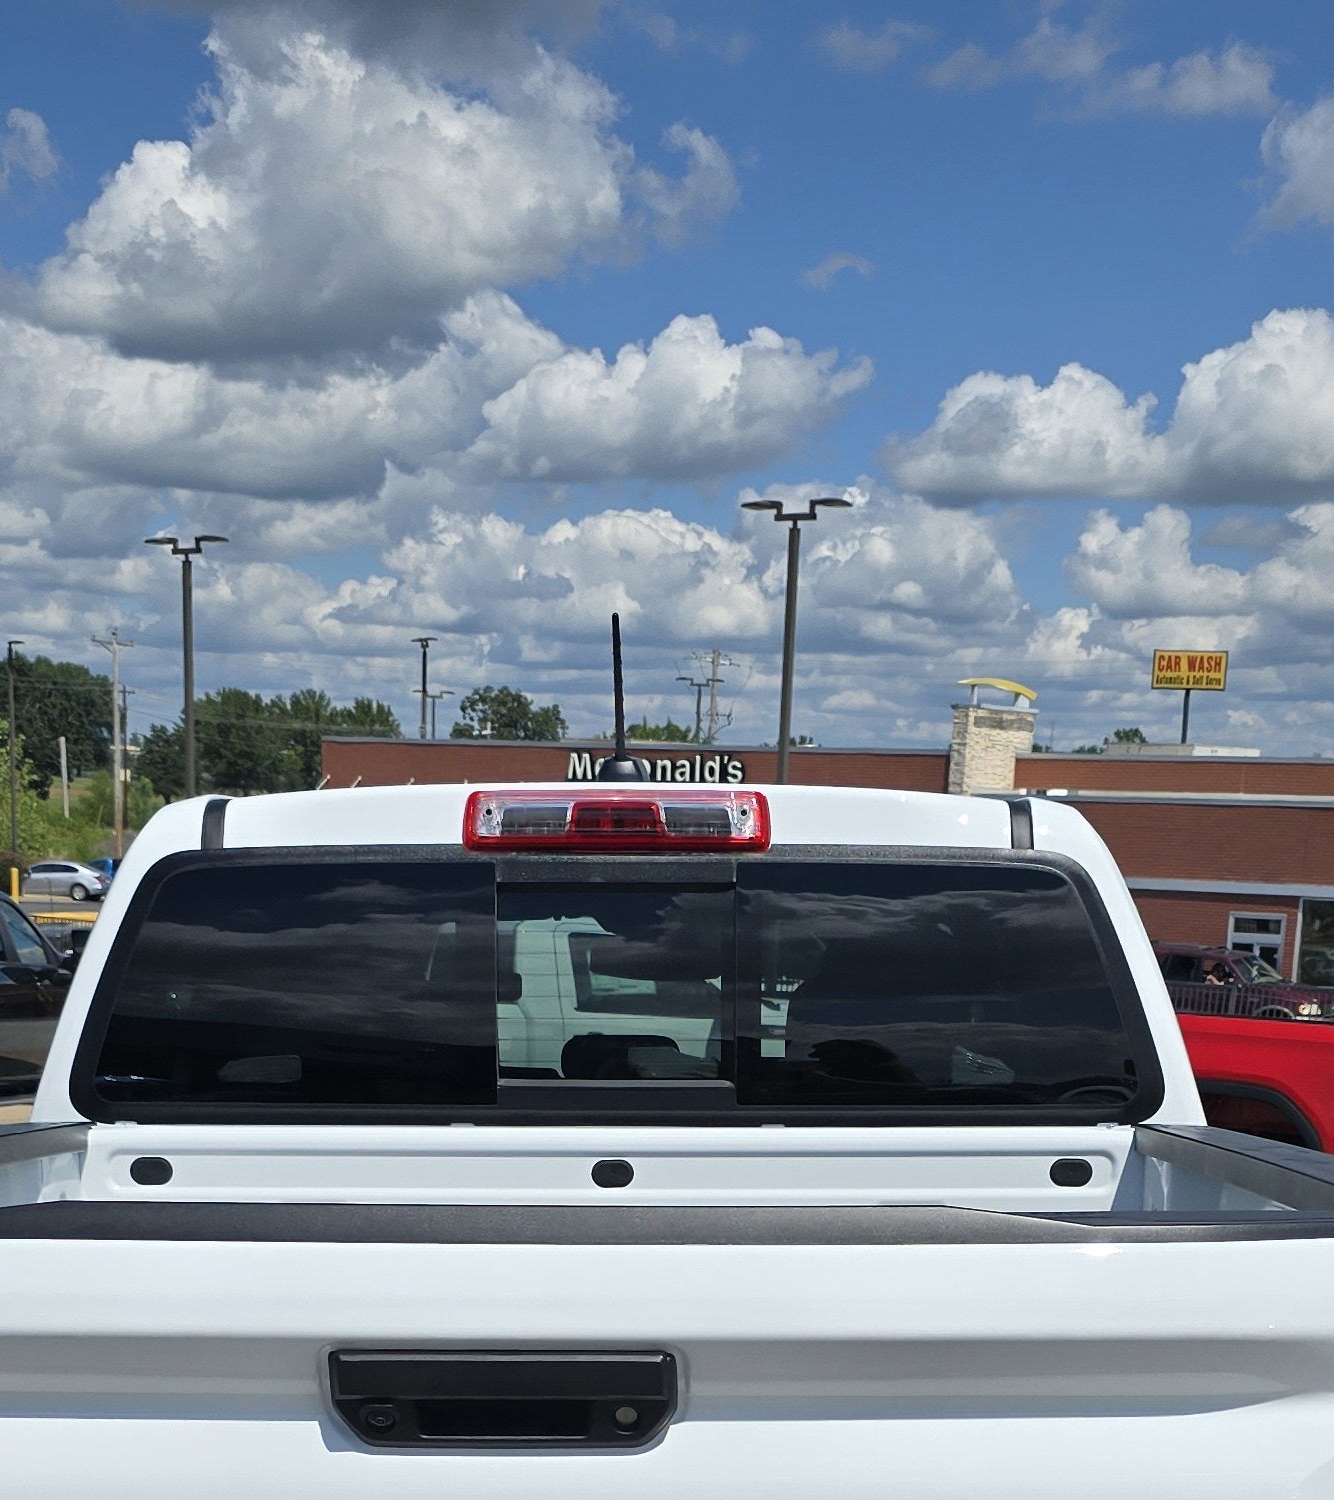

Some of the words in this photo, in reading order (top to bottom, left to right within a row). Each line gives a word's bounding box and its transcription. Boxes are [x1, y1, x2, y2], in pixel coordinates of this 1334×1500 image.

[1157, 655, 1181, 672] CAR
[1187, 655, 1223, 673] WASH
[567, 752, 743, 783] Mnald's
